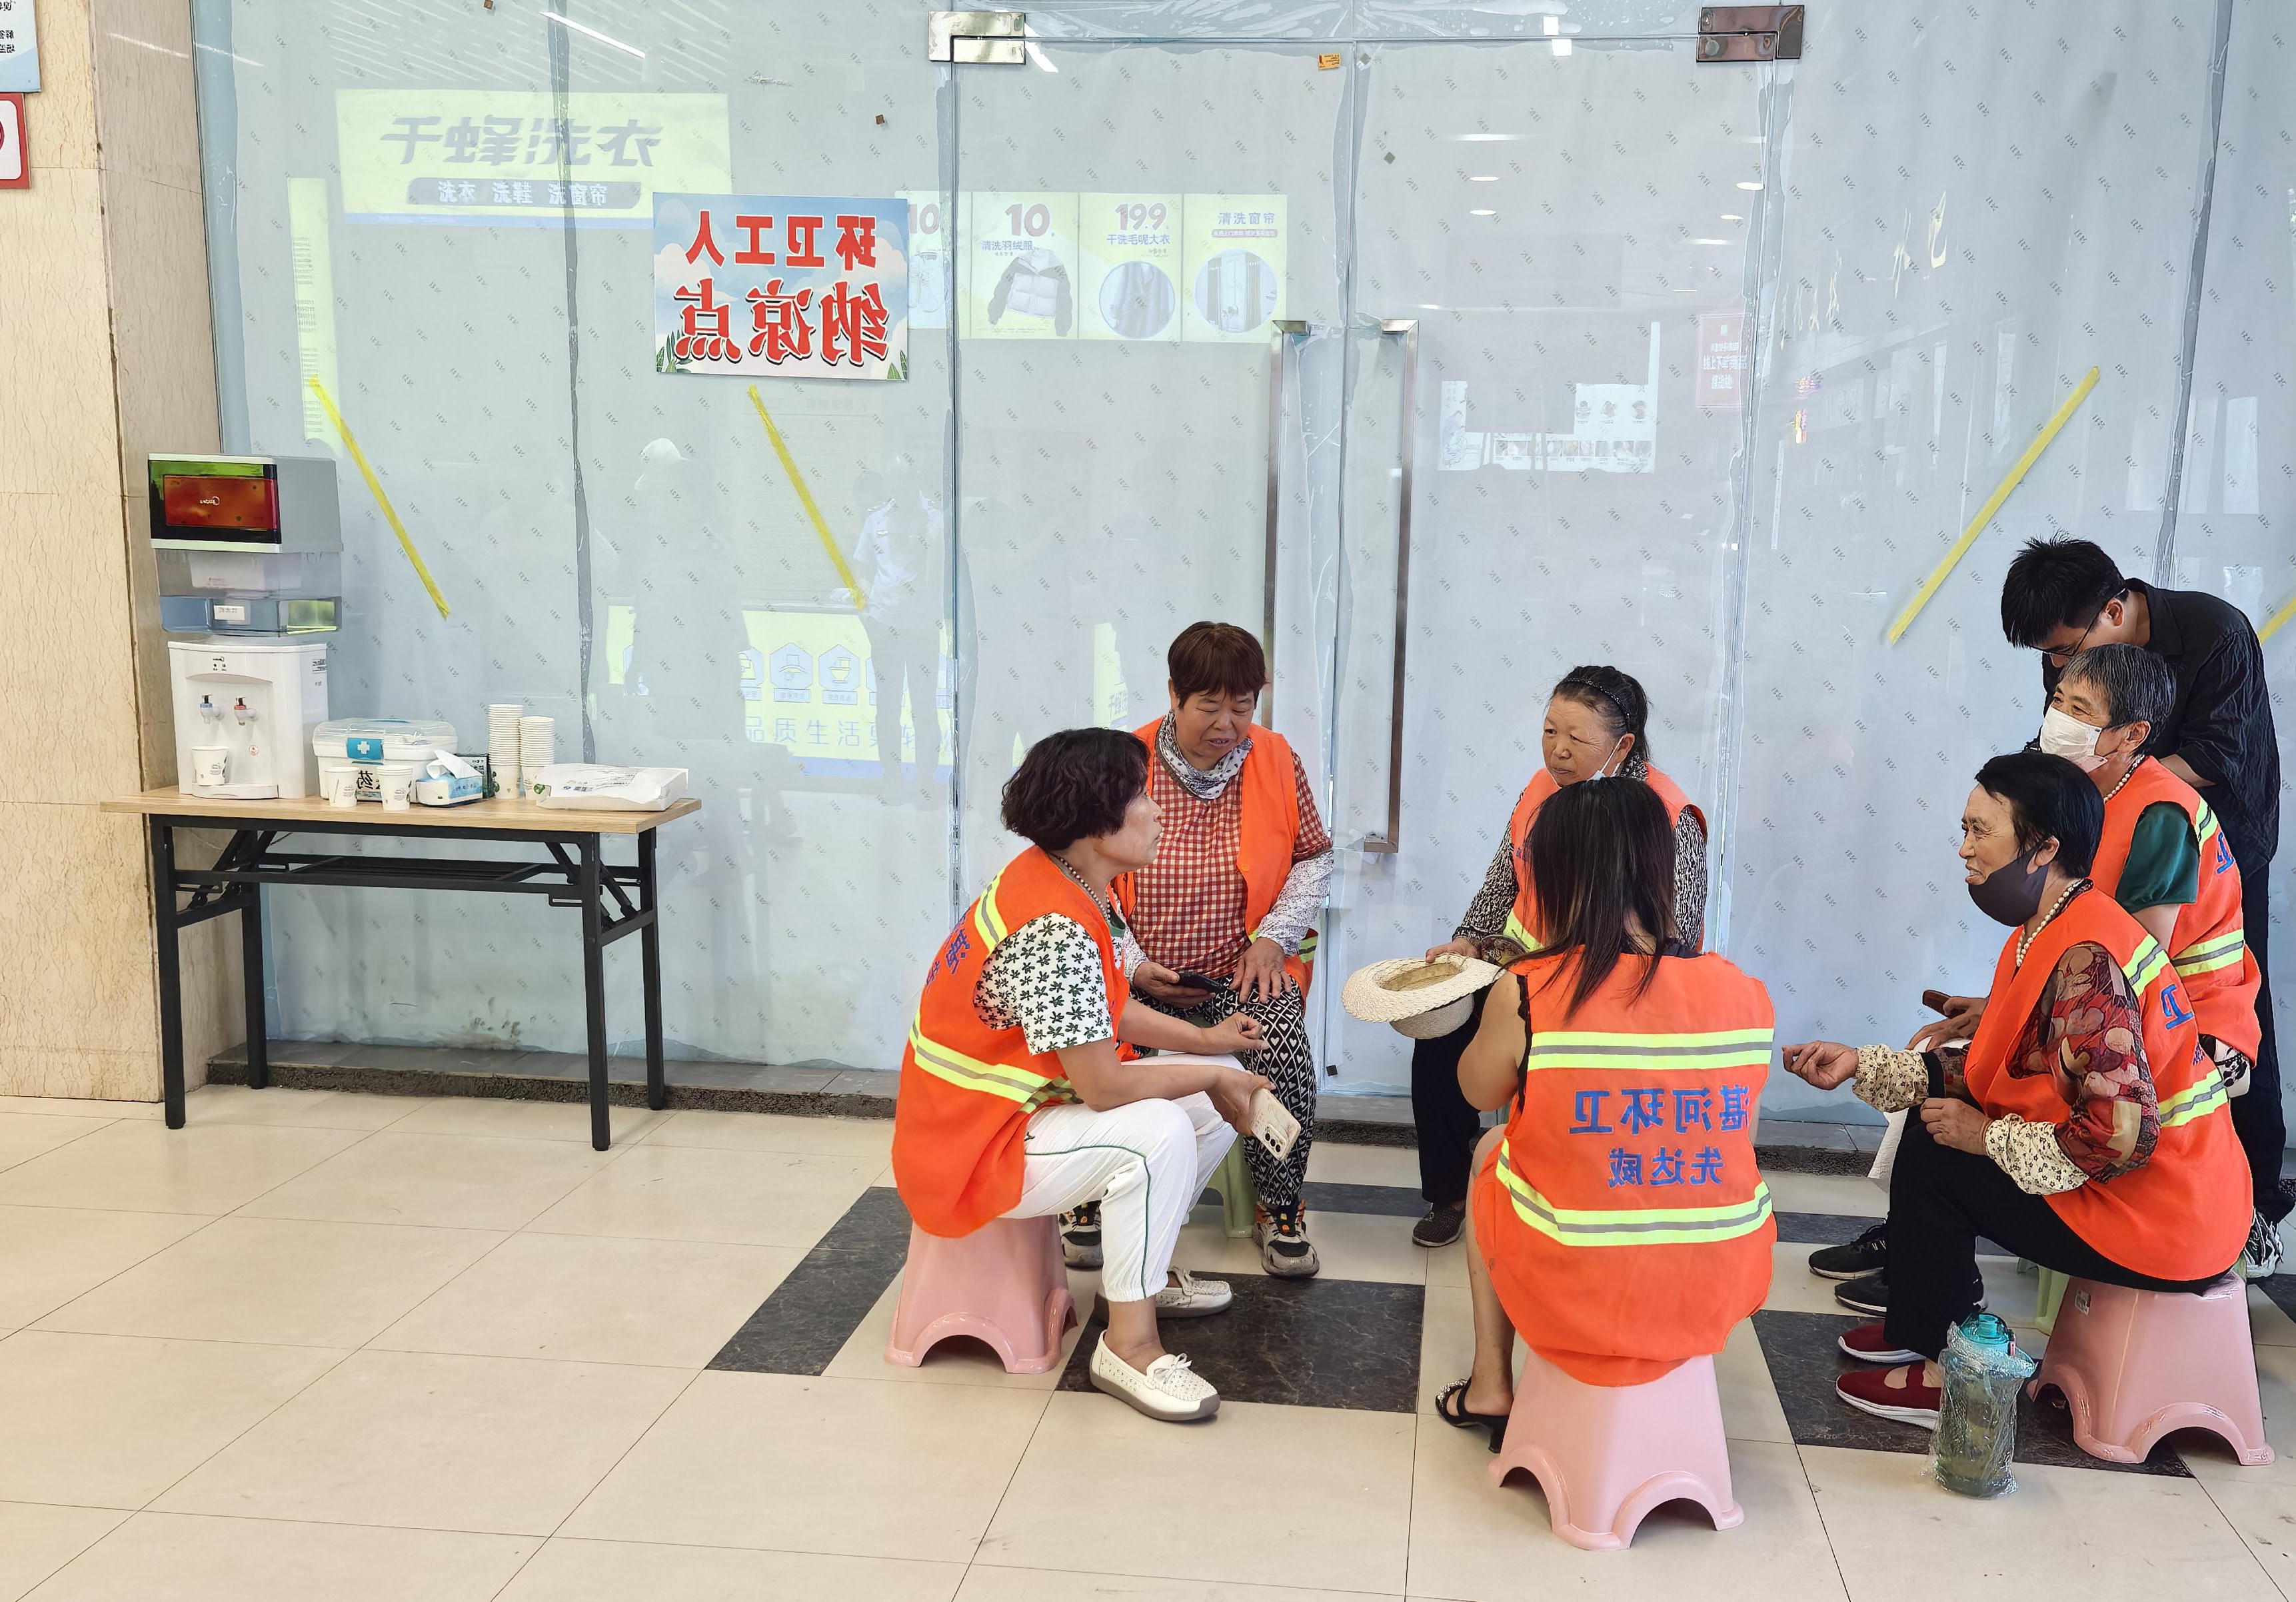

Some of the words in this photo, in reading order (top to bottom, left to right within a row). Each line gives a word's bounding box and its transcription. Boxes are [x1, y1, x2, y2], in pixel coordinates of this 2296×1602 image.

[438, 180, 476, 203] 洗衣
[492, 181, 533, 204] 洗鞋
[1004, 203, 1050, 237] 10
[1218, 212, 1276, 225] 清洗窗帘
[981, 240, 1034, 251] 清洗羽绒服
[1106, 233, 1171, 245] 干洗毛呢大衣
